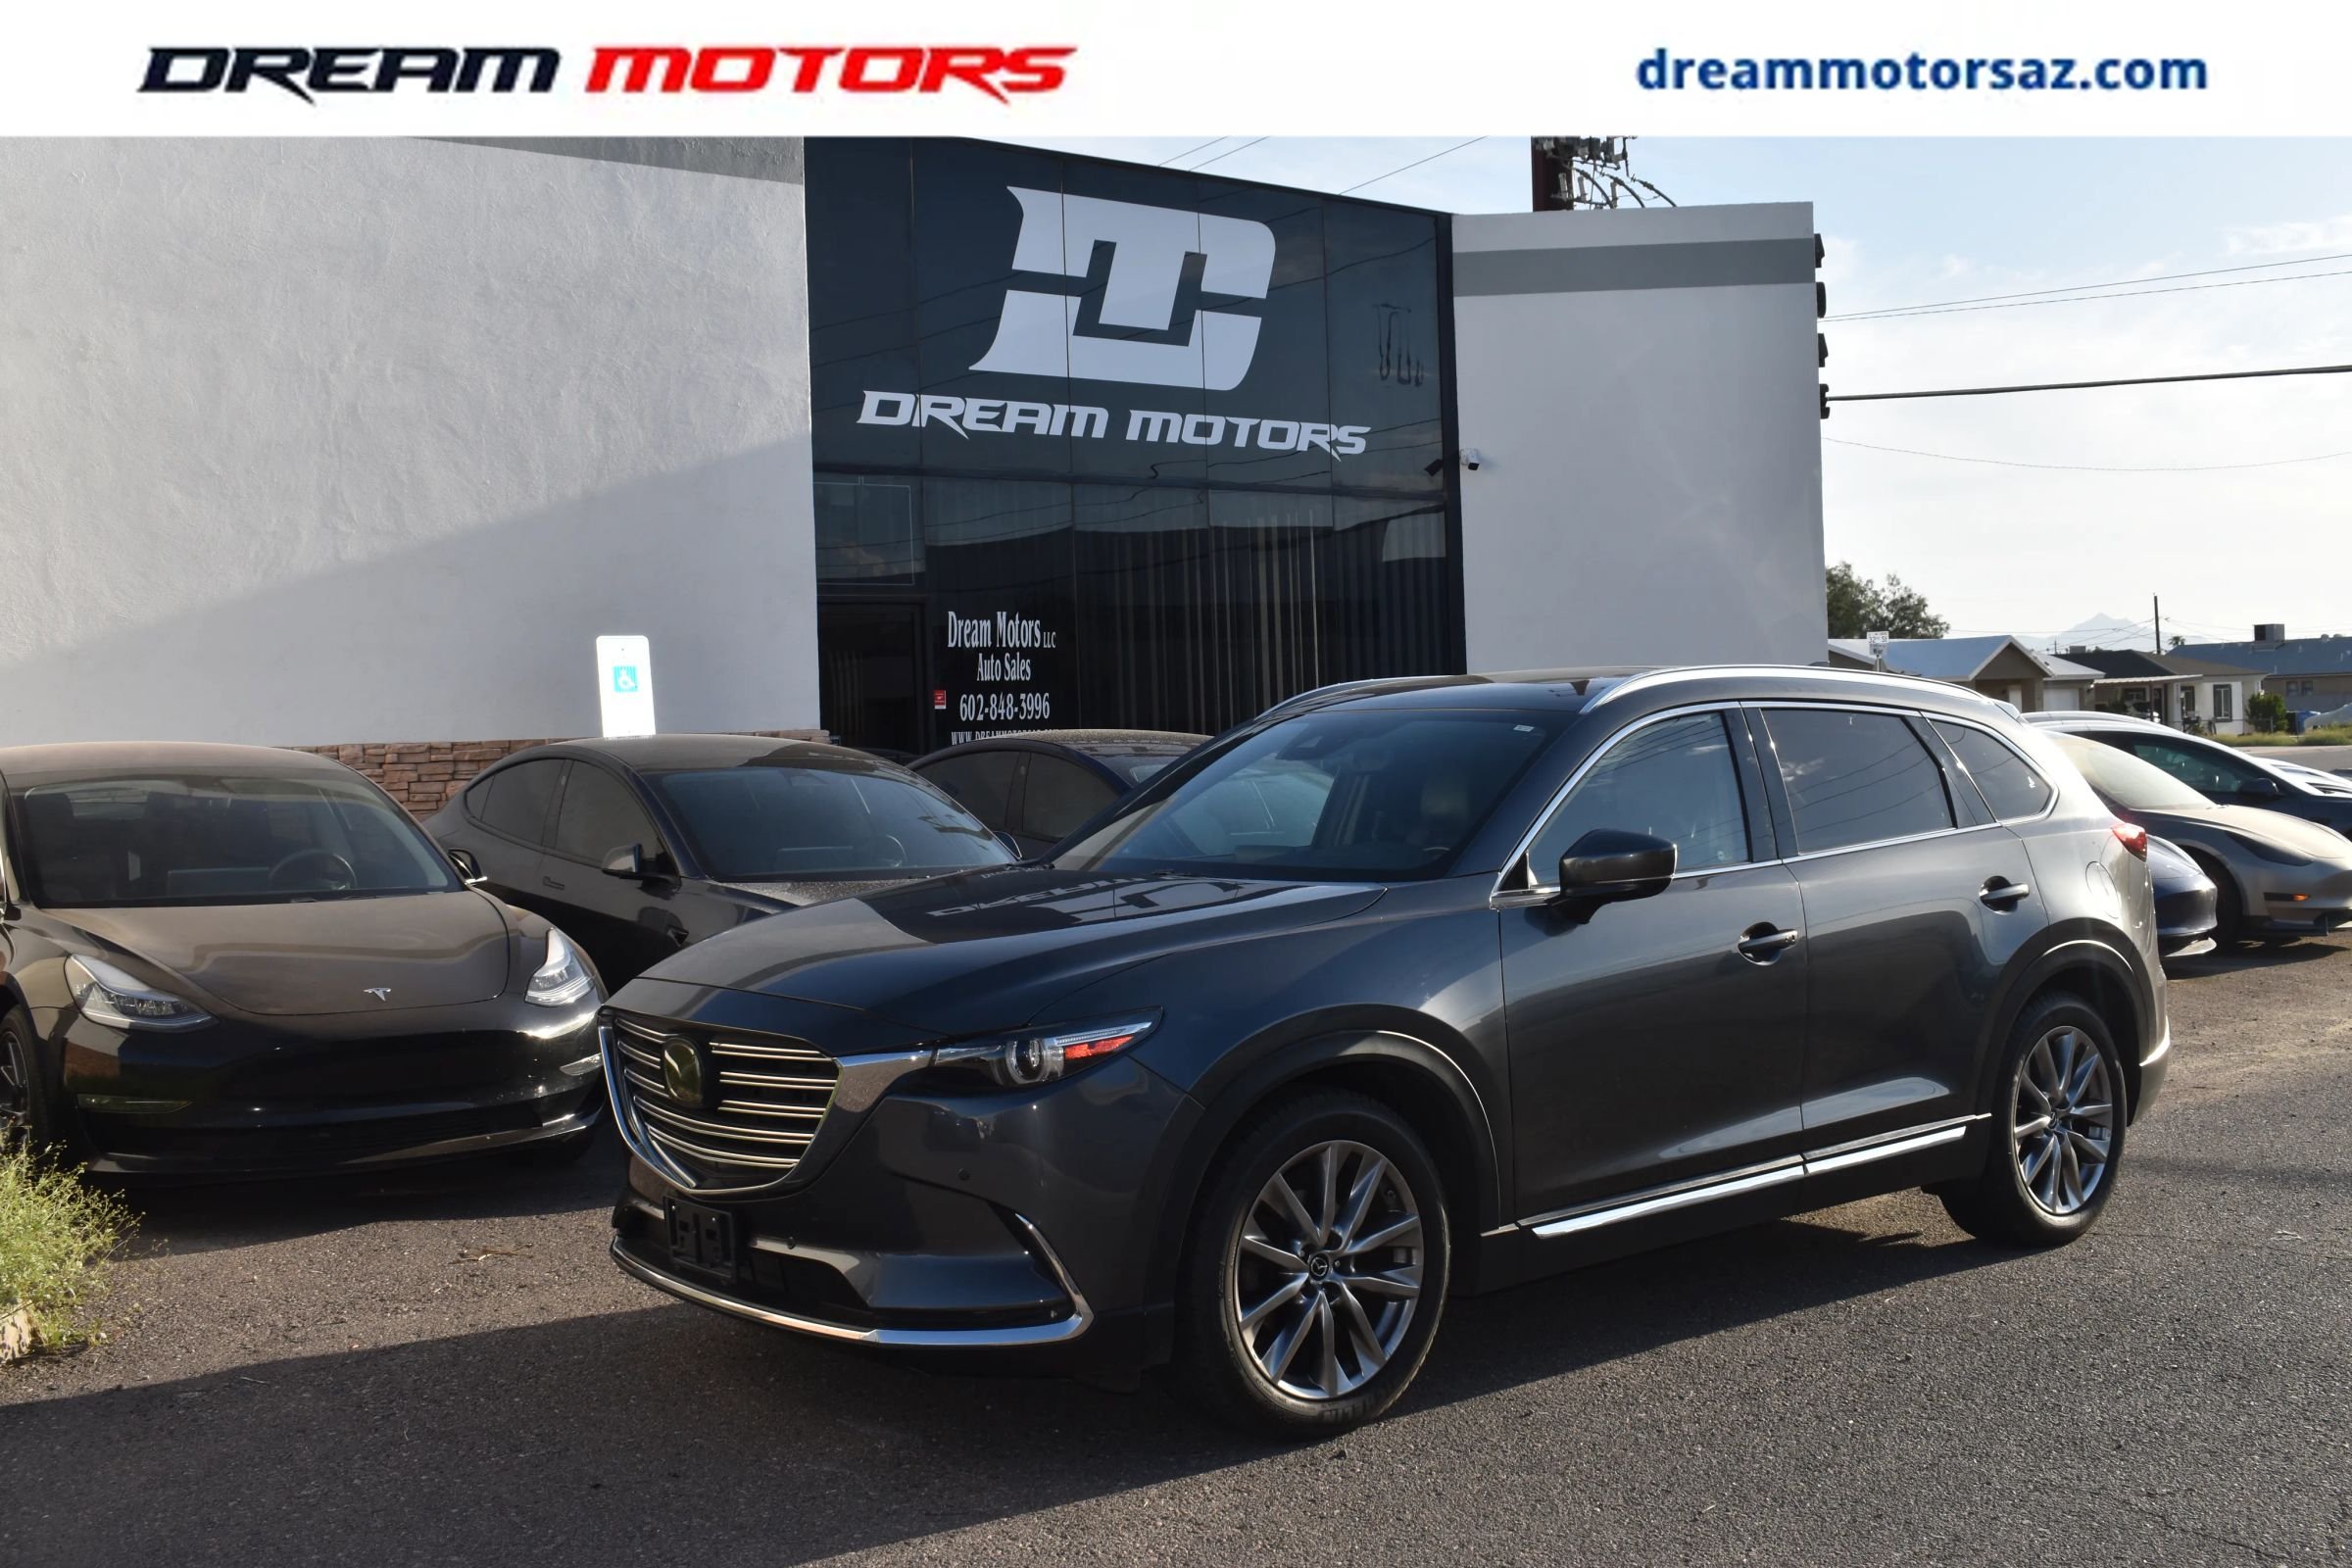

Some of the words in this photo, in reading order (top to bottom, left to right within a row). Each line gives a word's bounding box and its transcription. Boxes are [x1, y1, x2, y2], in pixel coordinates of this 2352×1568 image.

[857, 390, 1108, 440] DREAM
[1126, 410, 1371, 462] MOTORS
[948, 611, 992, 649] Dream
[996, 611, 1041, 649] Motors
[1043, 631, 1056, 649] LLC
[976, 652, 1002, 681] Auto
[1004, 651, 1031, 681] Sales
[959, 692, 1051, 721] 602-848-3996
